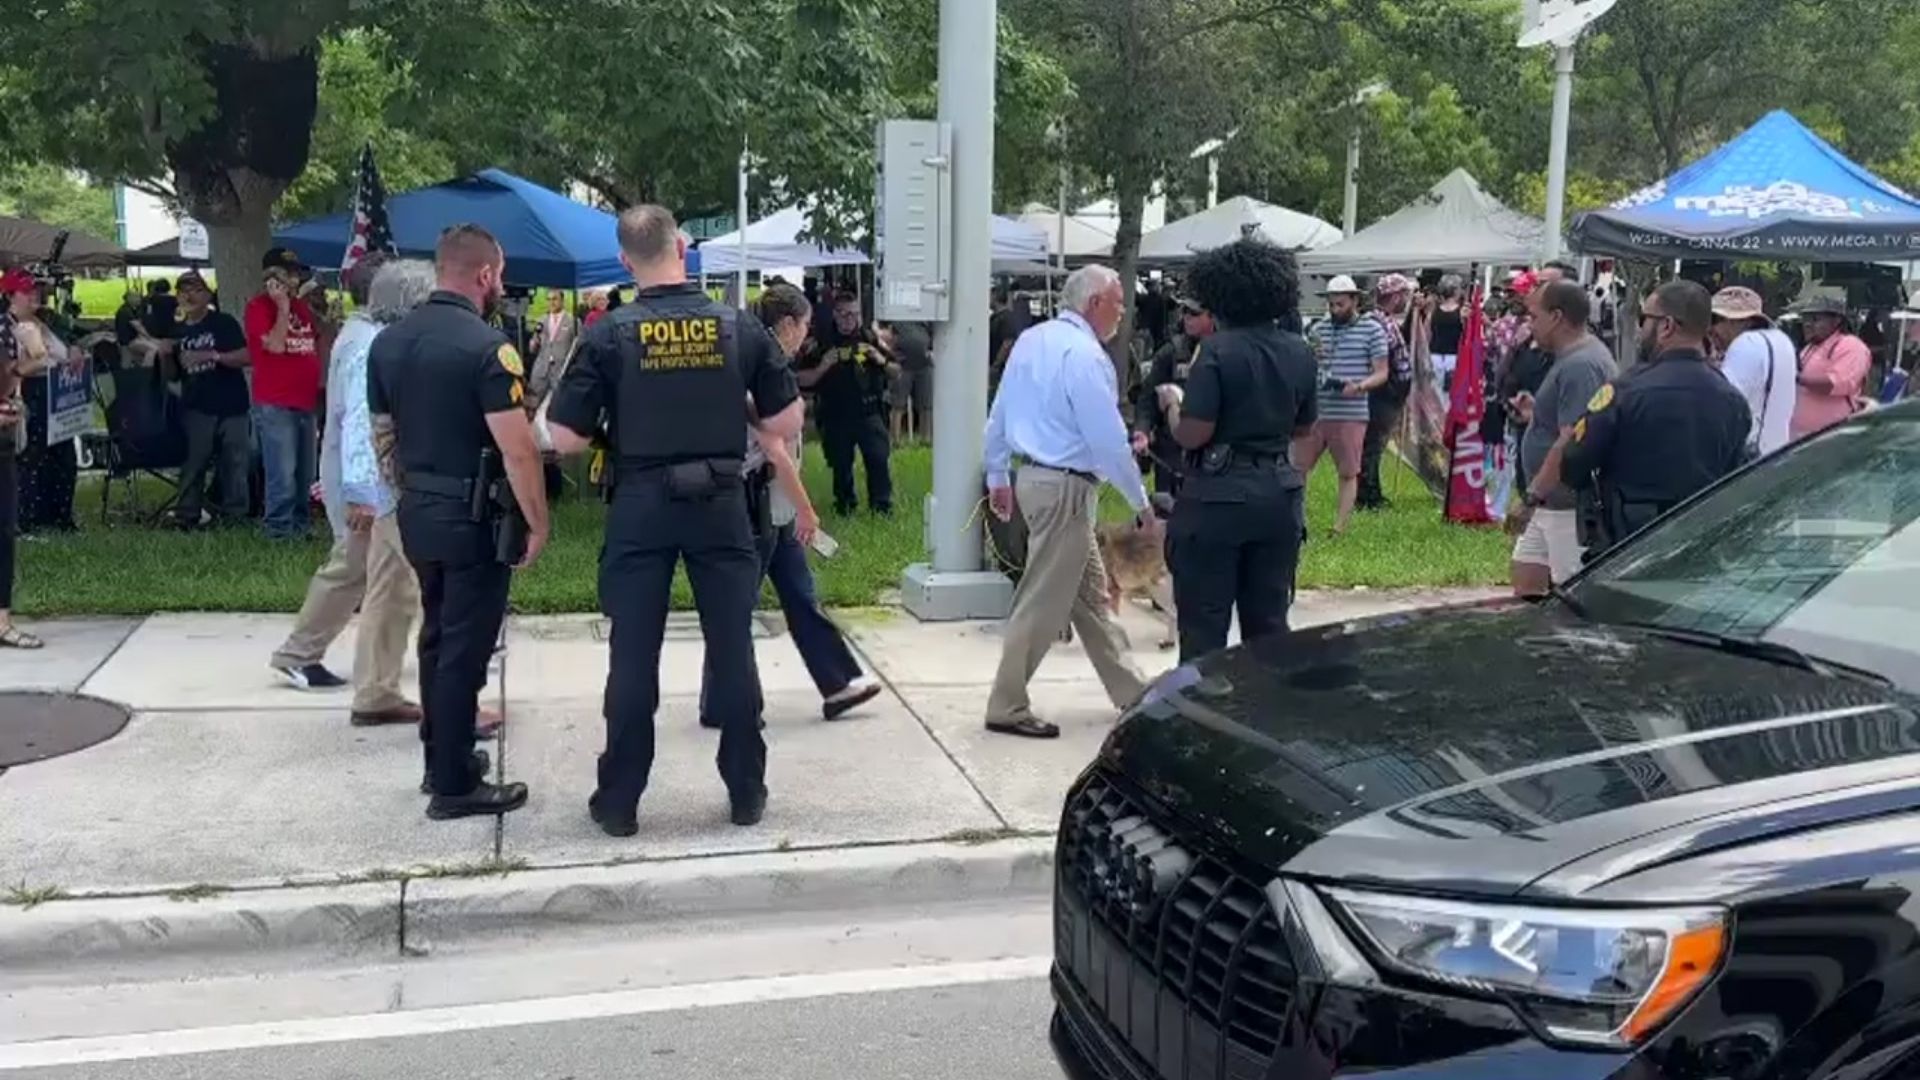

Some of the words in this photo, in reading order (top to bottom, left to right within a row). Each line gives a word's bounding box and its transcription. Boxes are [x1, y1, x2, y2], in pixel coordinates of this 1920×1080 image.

[1688, 236, 1738, 249] CANAL
[1742, 236, 1760, 249] 22
[639, 319, 719, 344] POLICE
